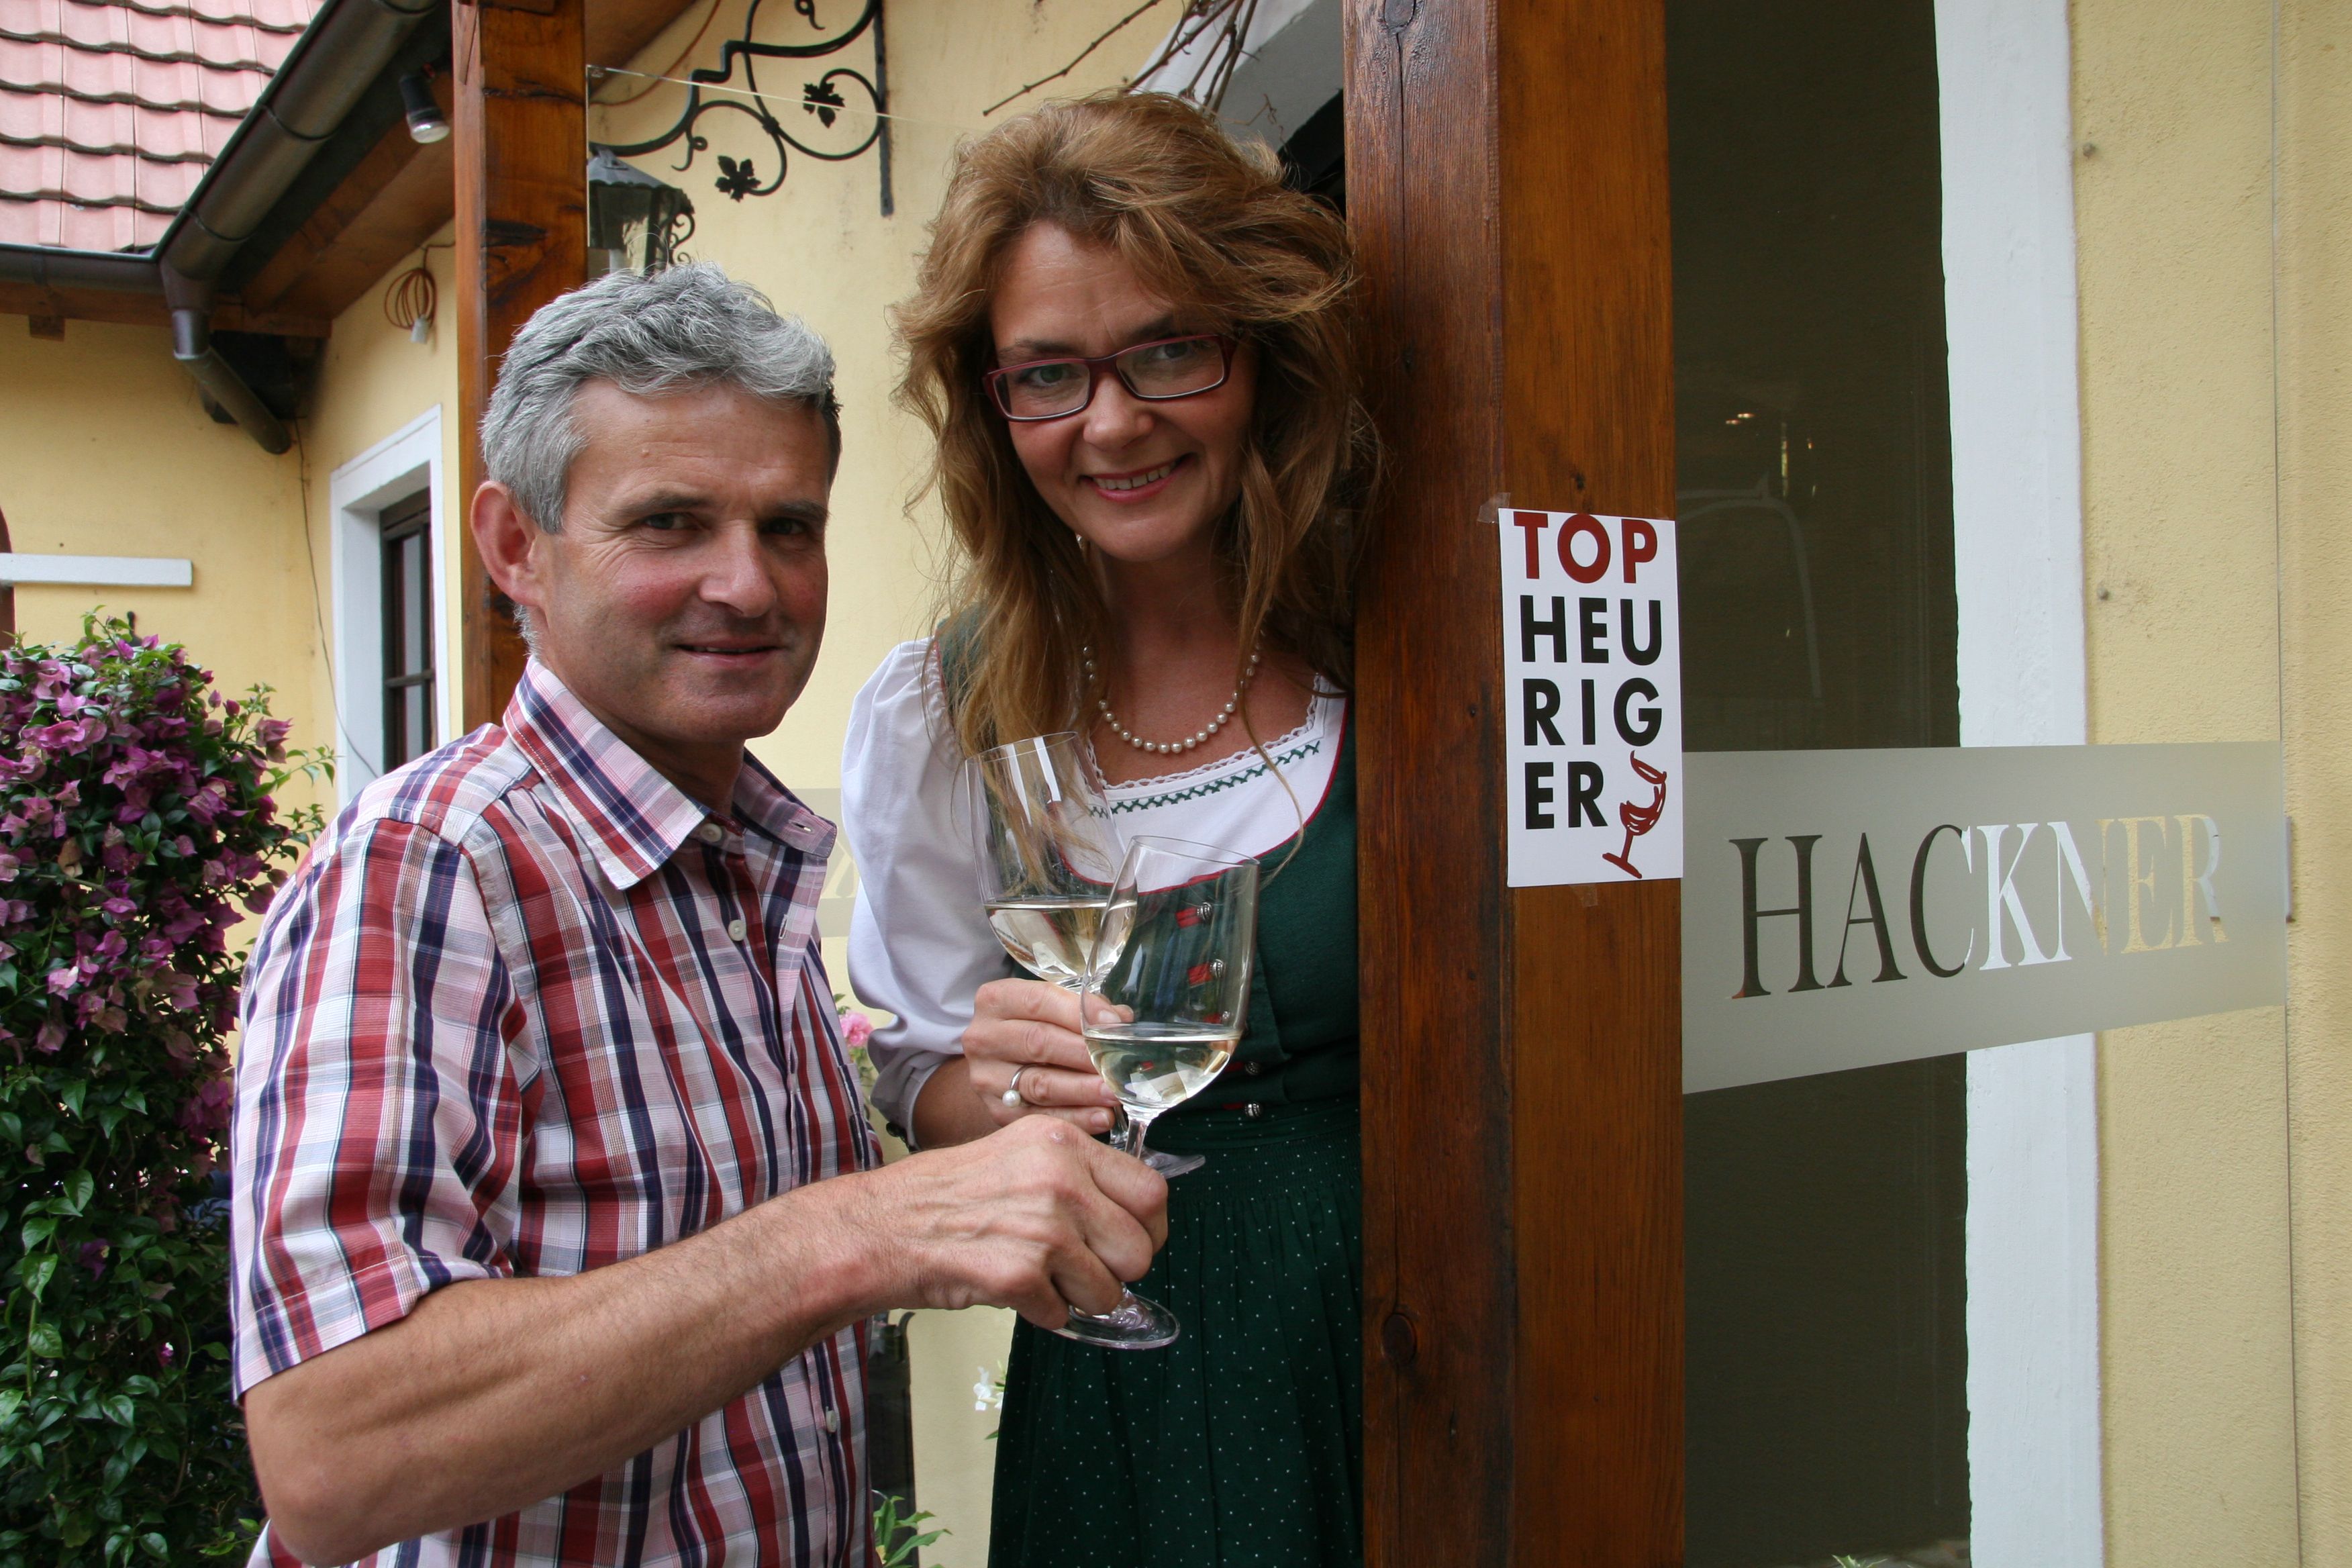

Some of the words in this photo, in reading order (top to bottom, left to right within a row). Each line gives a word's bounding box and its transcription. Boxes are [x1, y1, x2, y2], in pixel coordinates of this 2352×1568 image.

[1513, 511, 1658, 584] TOP
[1519, 595, 1663, 666] HEU
[1522, 677, 1663, 747] RIG
[1524, 761, 1608, 830] ER
[1728, 813, 2228, 999] HACKNER
